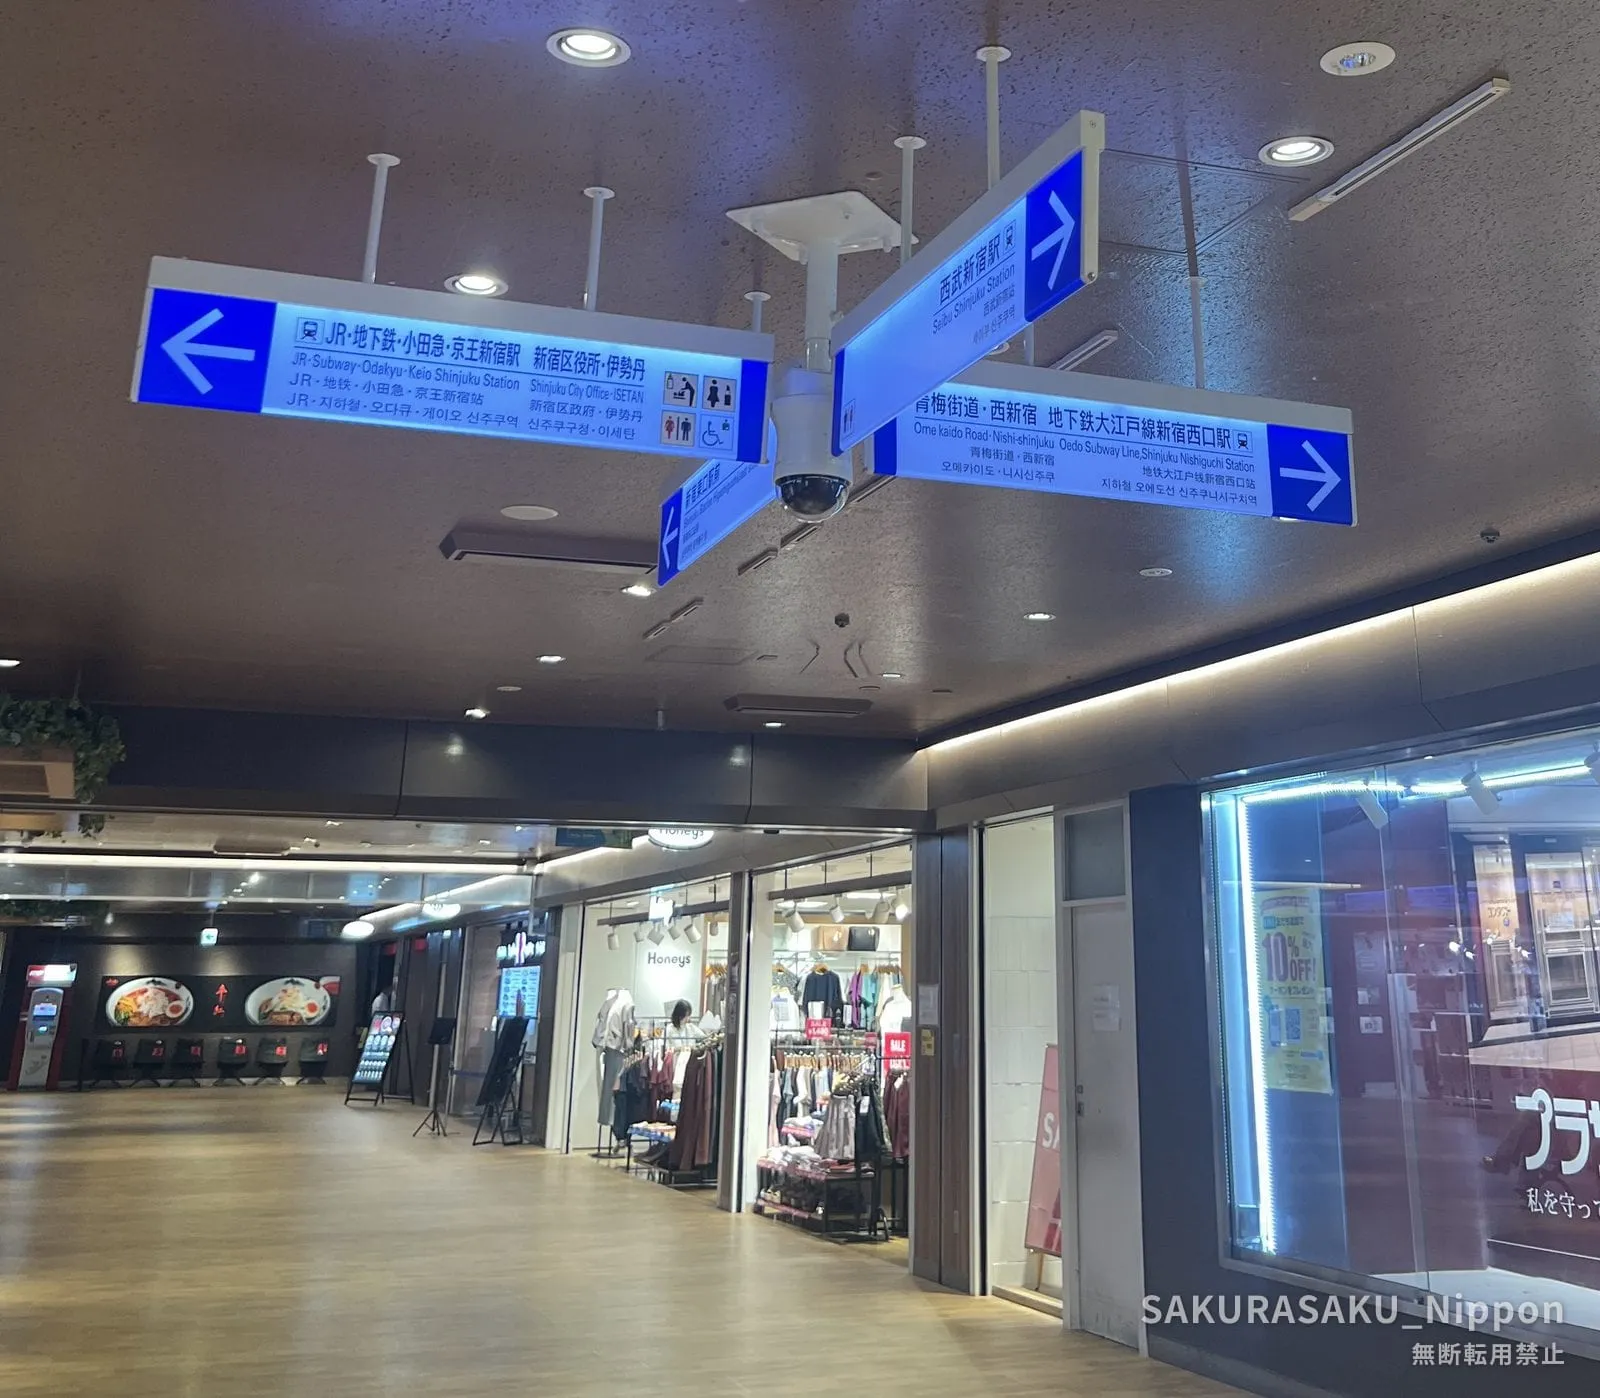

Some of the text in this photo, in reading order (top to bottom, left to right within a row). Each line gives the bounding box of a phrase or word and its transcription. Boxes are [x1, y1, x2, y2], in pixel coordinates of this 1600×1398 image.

[940, 234, 1001, 306] 西武新宿駅
[932, 264, 1015, 335] Seibu Shinjuku Station
[434, 366, 480, 387] Shinjuku
[483, 374, 520, 391] Station
[530, 378, 566, 396] Shinjuku
[567, 383, 584, 400] City
[914, 422, 937, 435] Ome
[938, 424, 963, 439] kaido
[1048, 406, 1232, 450] 地下鉄大江戸線新宿西口駅
[1059, 438, 1083, 452] Oedo
[1085, 441, 1120, 459] Subway
[1180, 452, 1224, 470] Nishiguchi
[1225, 458, 1255, 473] Station
[1102, 478, 1132, 492] 지하철
[1135, 482, 1175, 496] 오에도선
[648, 952, 691, 968] Honeys
[890, 1039, 906, 1052] SALE
